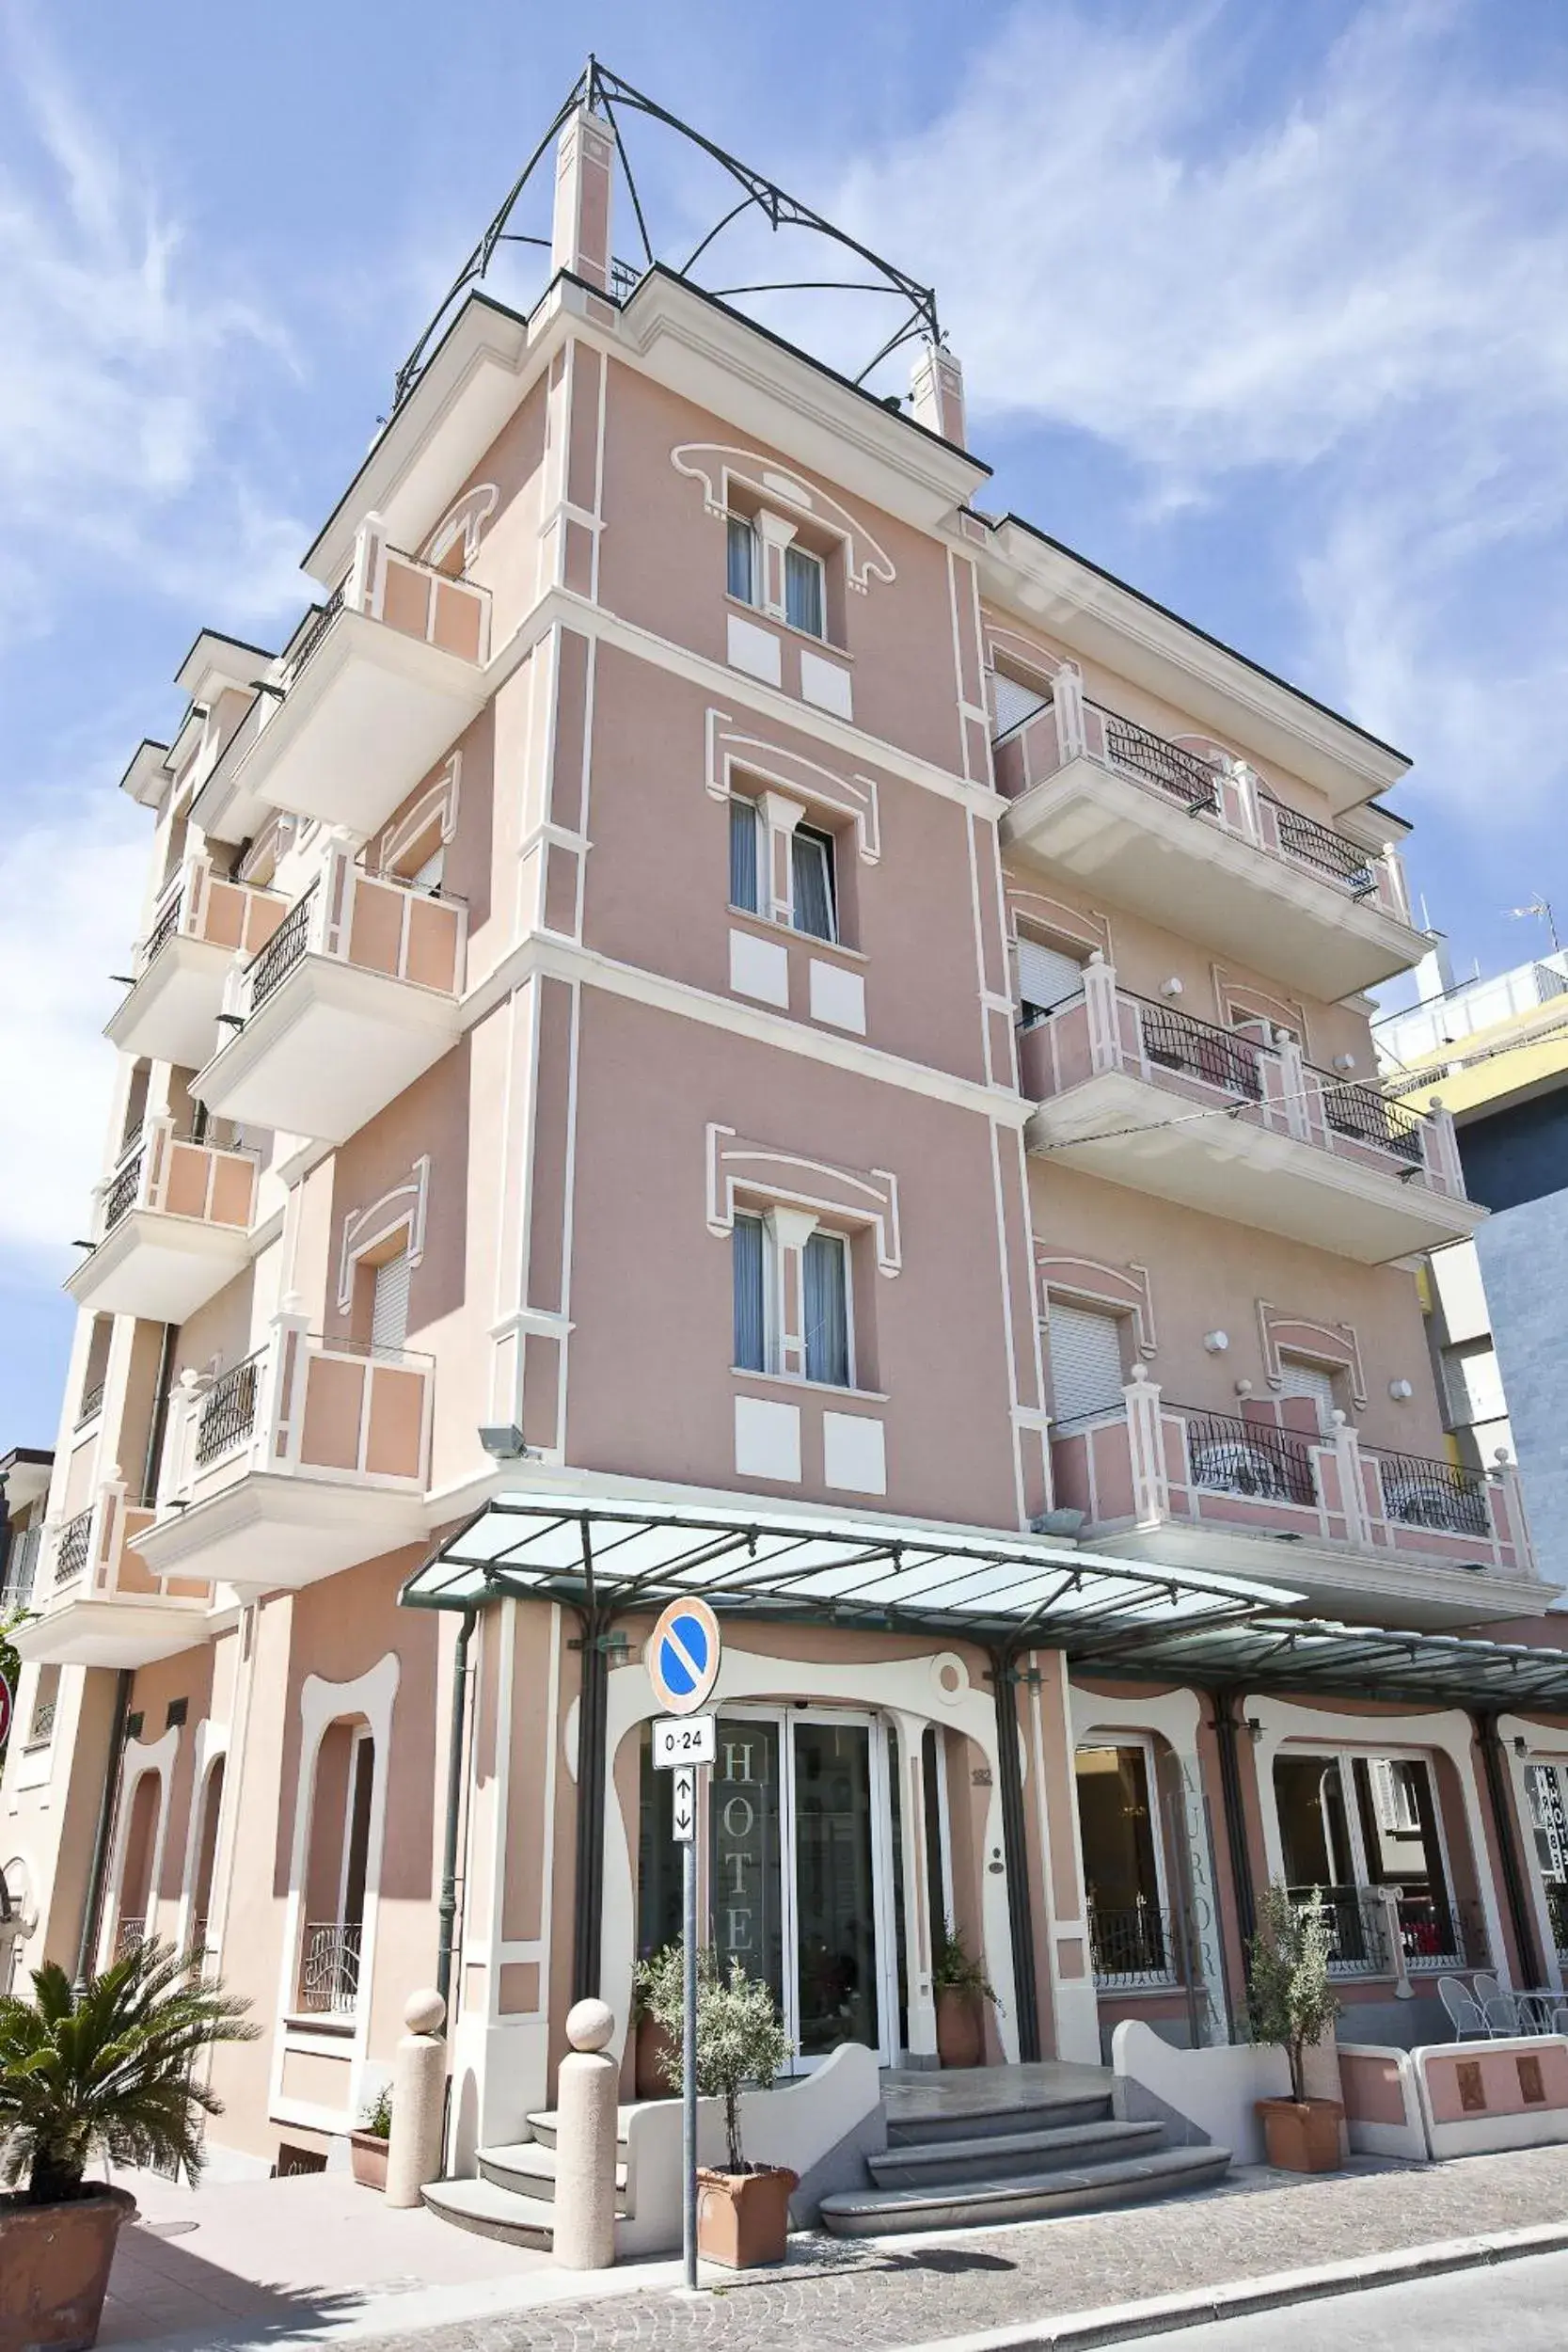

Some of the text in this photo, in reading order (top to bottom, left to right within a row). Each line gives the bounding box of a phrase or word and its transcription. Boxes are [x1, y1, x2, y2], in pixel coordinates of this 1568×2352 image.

[665, 1730, 702, 1752] 0-24
[721, 1742, 753, 1951] HOTE
[1181, 1760, 1222, 2025] AURORA
